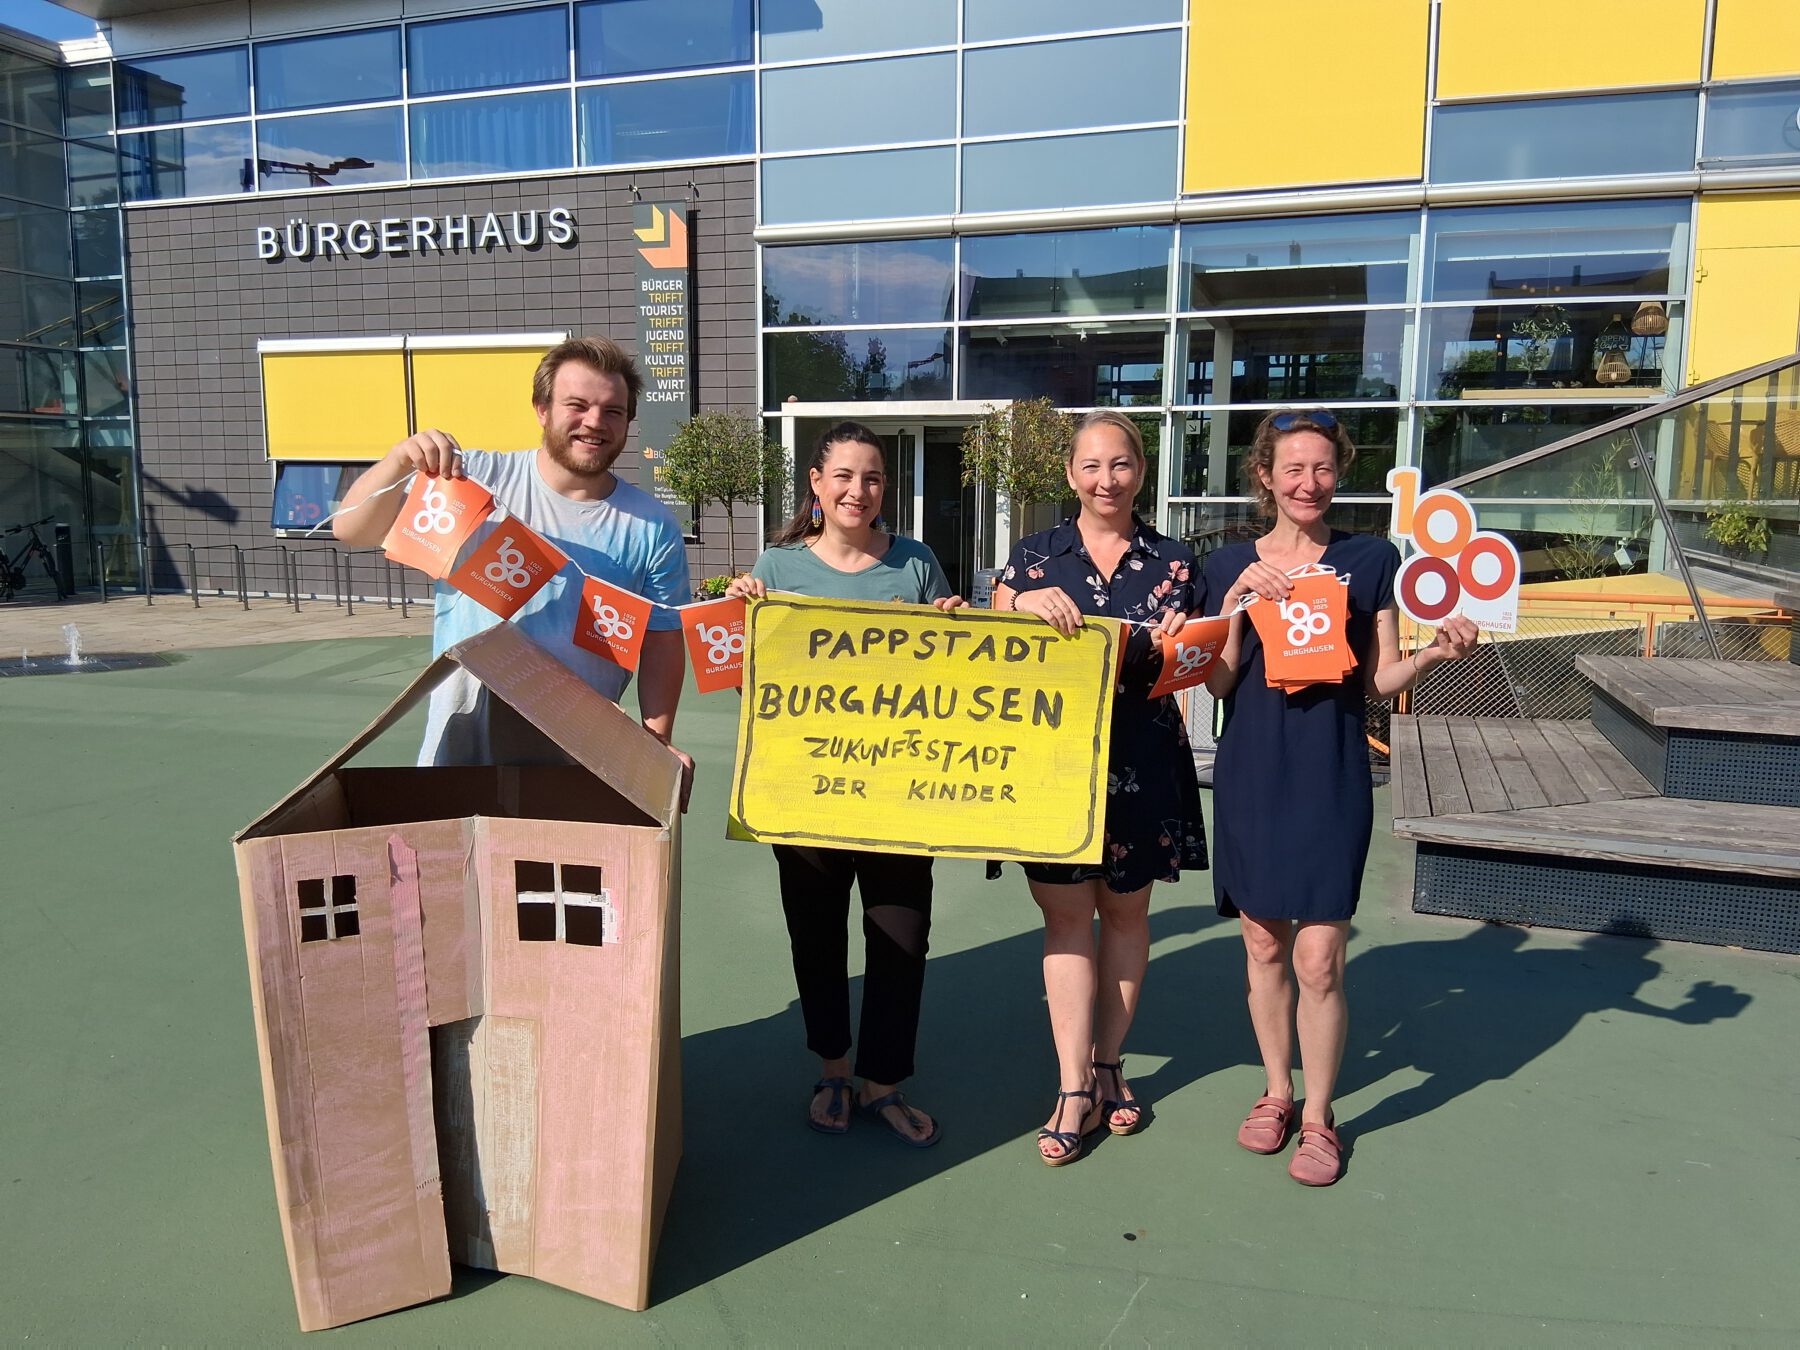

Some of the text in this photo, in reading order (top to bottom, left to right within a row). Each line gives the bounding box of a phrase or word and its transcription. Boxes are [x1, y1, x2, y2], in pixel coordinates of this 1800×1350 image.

[257, 207, 577, 260] BÜRGERHAUS
[641, 278, 683, 291] BÜRGER
[648, 292, 684, 303] TRIFFT
[640, 305, 684, 316] TOURIST
[649, 317, 685, 328] TRIFFT
[645, 330, 684, 343] JUGEND
[650, 342, 685, 353] TRIFFT
[645, 355, 685, 366] KULTUR
[650, 367, 685, 377] TRIFFT
[656, 379, 686, 390] WIRT
[645, 391, 686, 402] SCHAFT
[401, 527, 441, 553] BURGHAUSEN
[470, 570, 514, 602] BURGHAUSEN
[1473, 620, 1512, 630] URGHAUSEN
[585, 630, 629, 655] BURGHAUSEN
[808, 627, 1060, 663] PAPPSTADT
[1283, 643, 1335, 657] BURGHAUSEN
[705, 661, 743, 674] BURGHAUS
[756, 682, 1064, 730] BURGHAUSEN
[803, 729, 1017, 773] ZUKUNFTSSTADT
[812, 773, 1017, 804] DER KINDER
